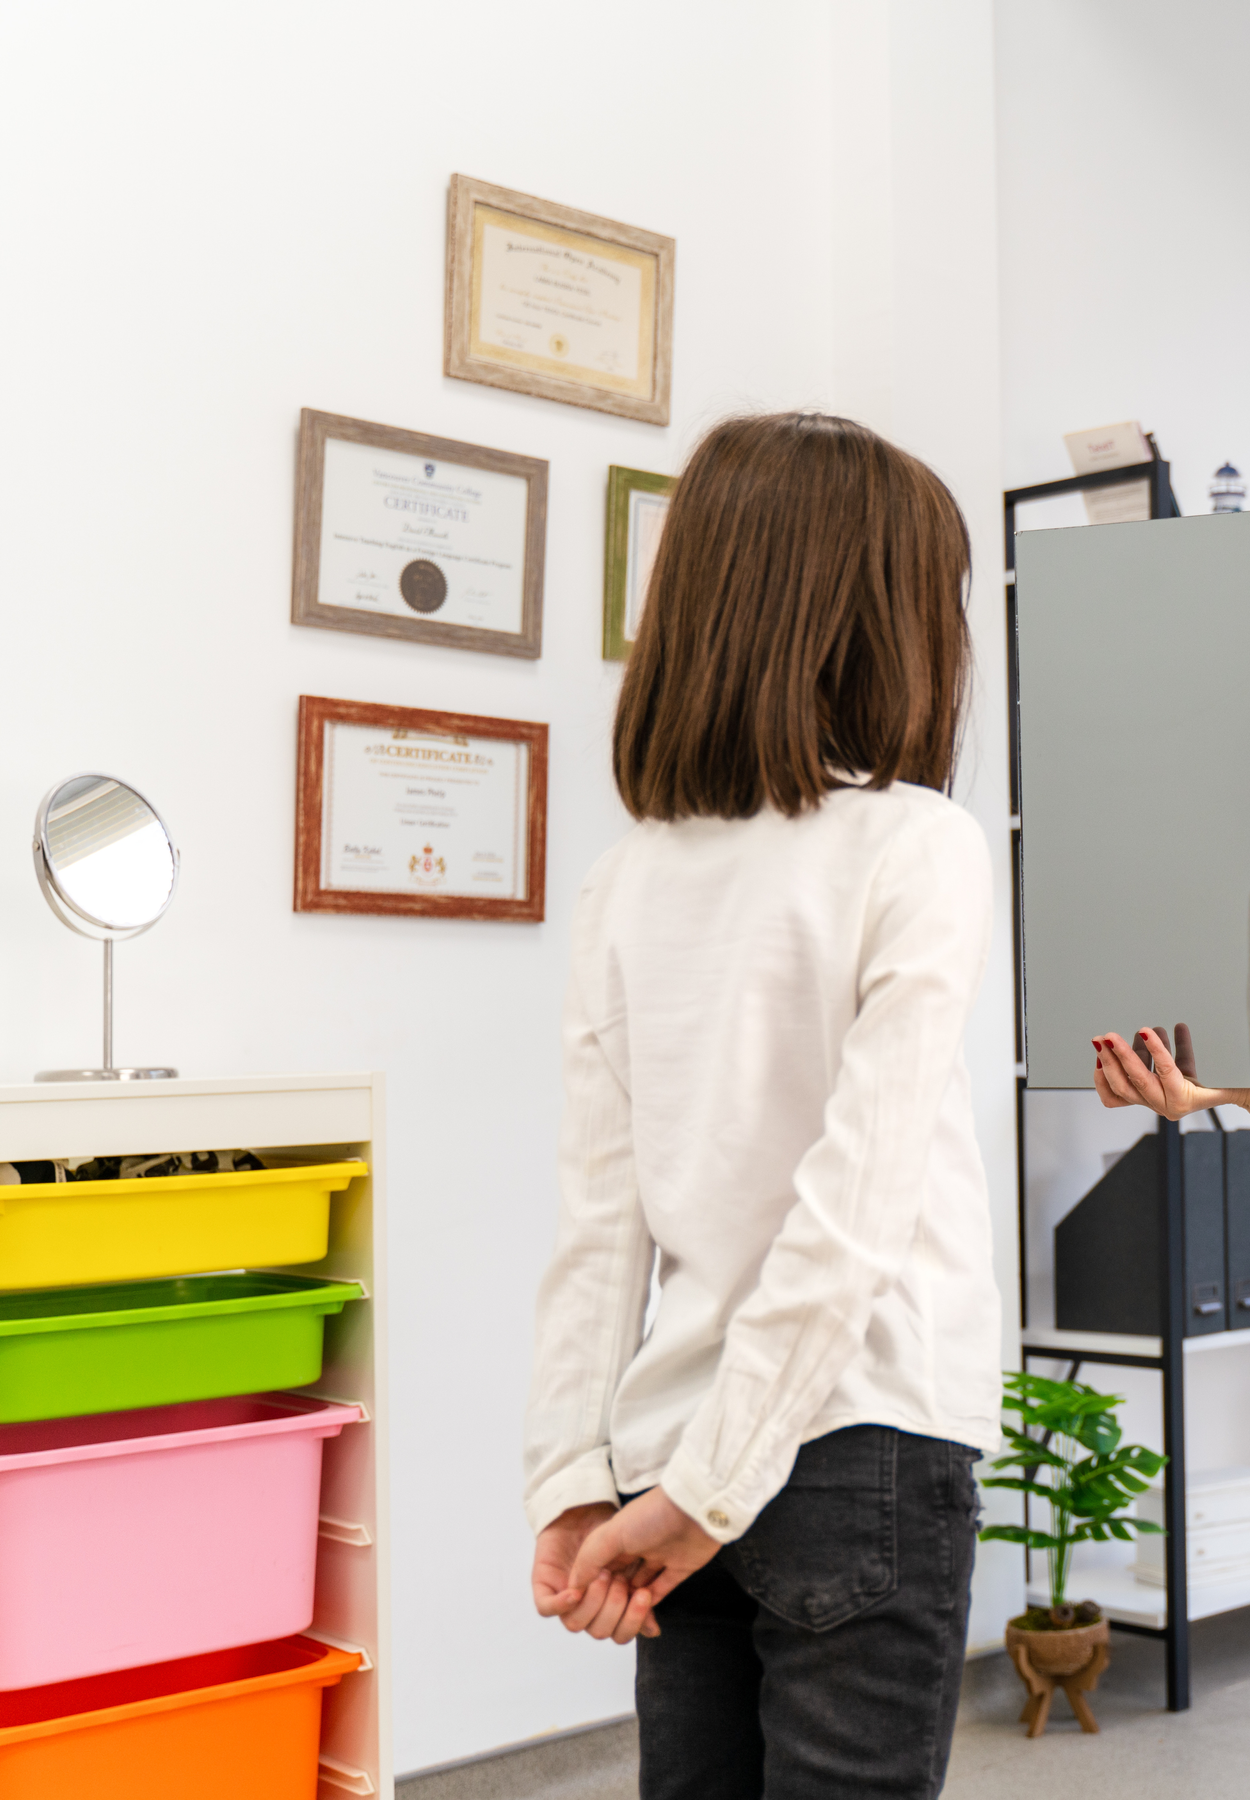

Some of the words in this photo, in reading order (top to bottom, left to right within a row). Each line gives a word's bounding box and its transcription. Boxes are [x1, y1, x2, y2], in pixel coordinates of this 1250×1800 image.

[455, 485, 482, 499] College
[383, 496, 470, 523] CERTIFICATE
[386, 745, 473, 764] CERTIFICATE
